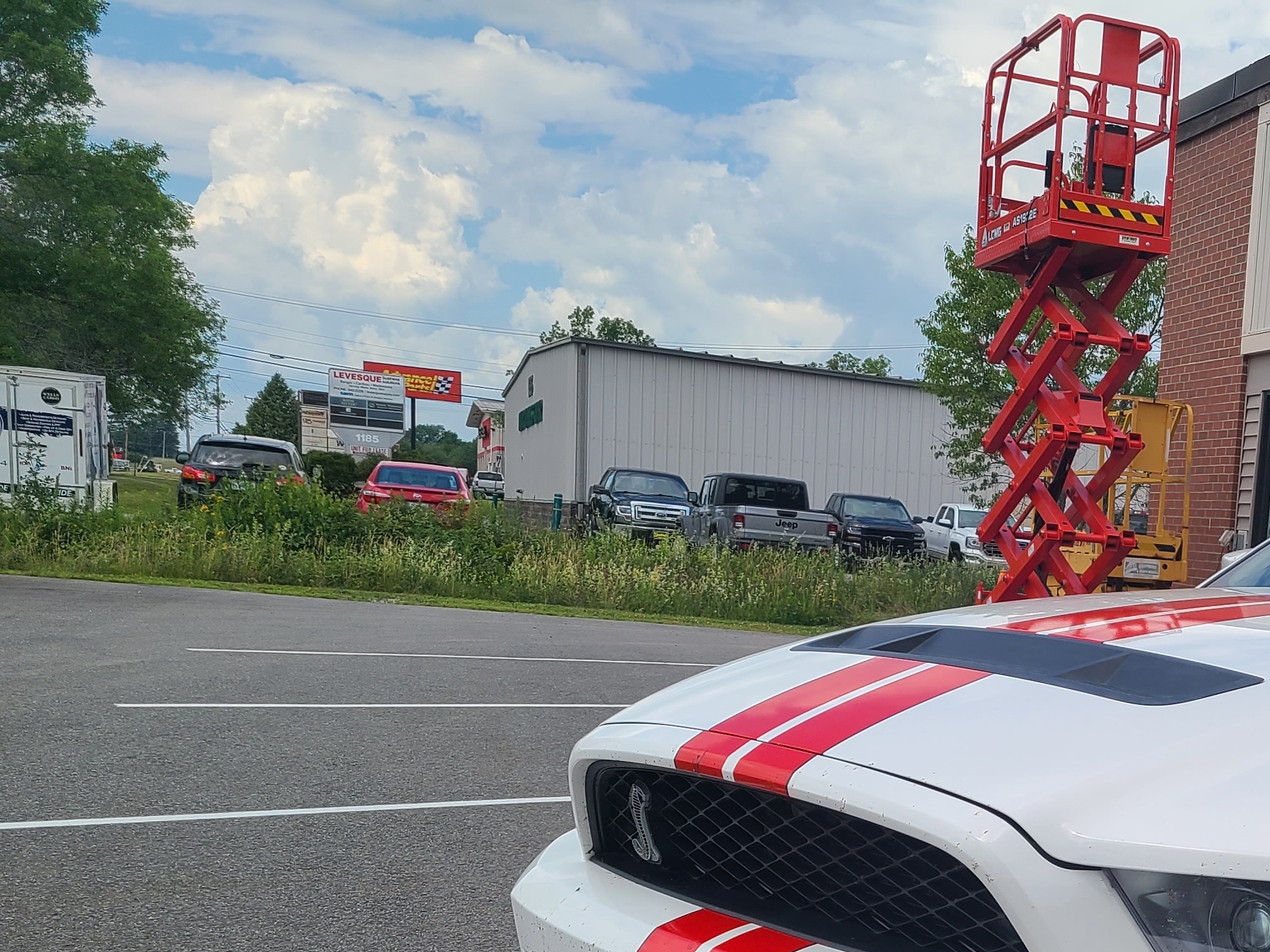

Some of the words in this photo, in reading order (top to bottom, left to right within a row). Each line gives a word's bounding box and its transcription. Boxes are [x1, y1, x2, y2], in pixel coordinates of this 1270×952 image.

[333, 371, 382, 383] LEVESQUE
[356, 433, 380, 443] 1185
[775, 519, 798, 529] Jeep
